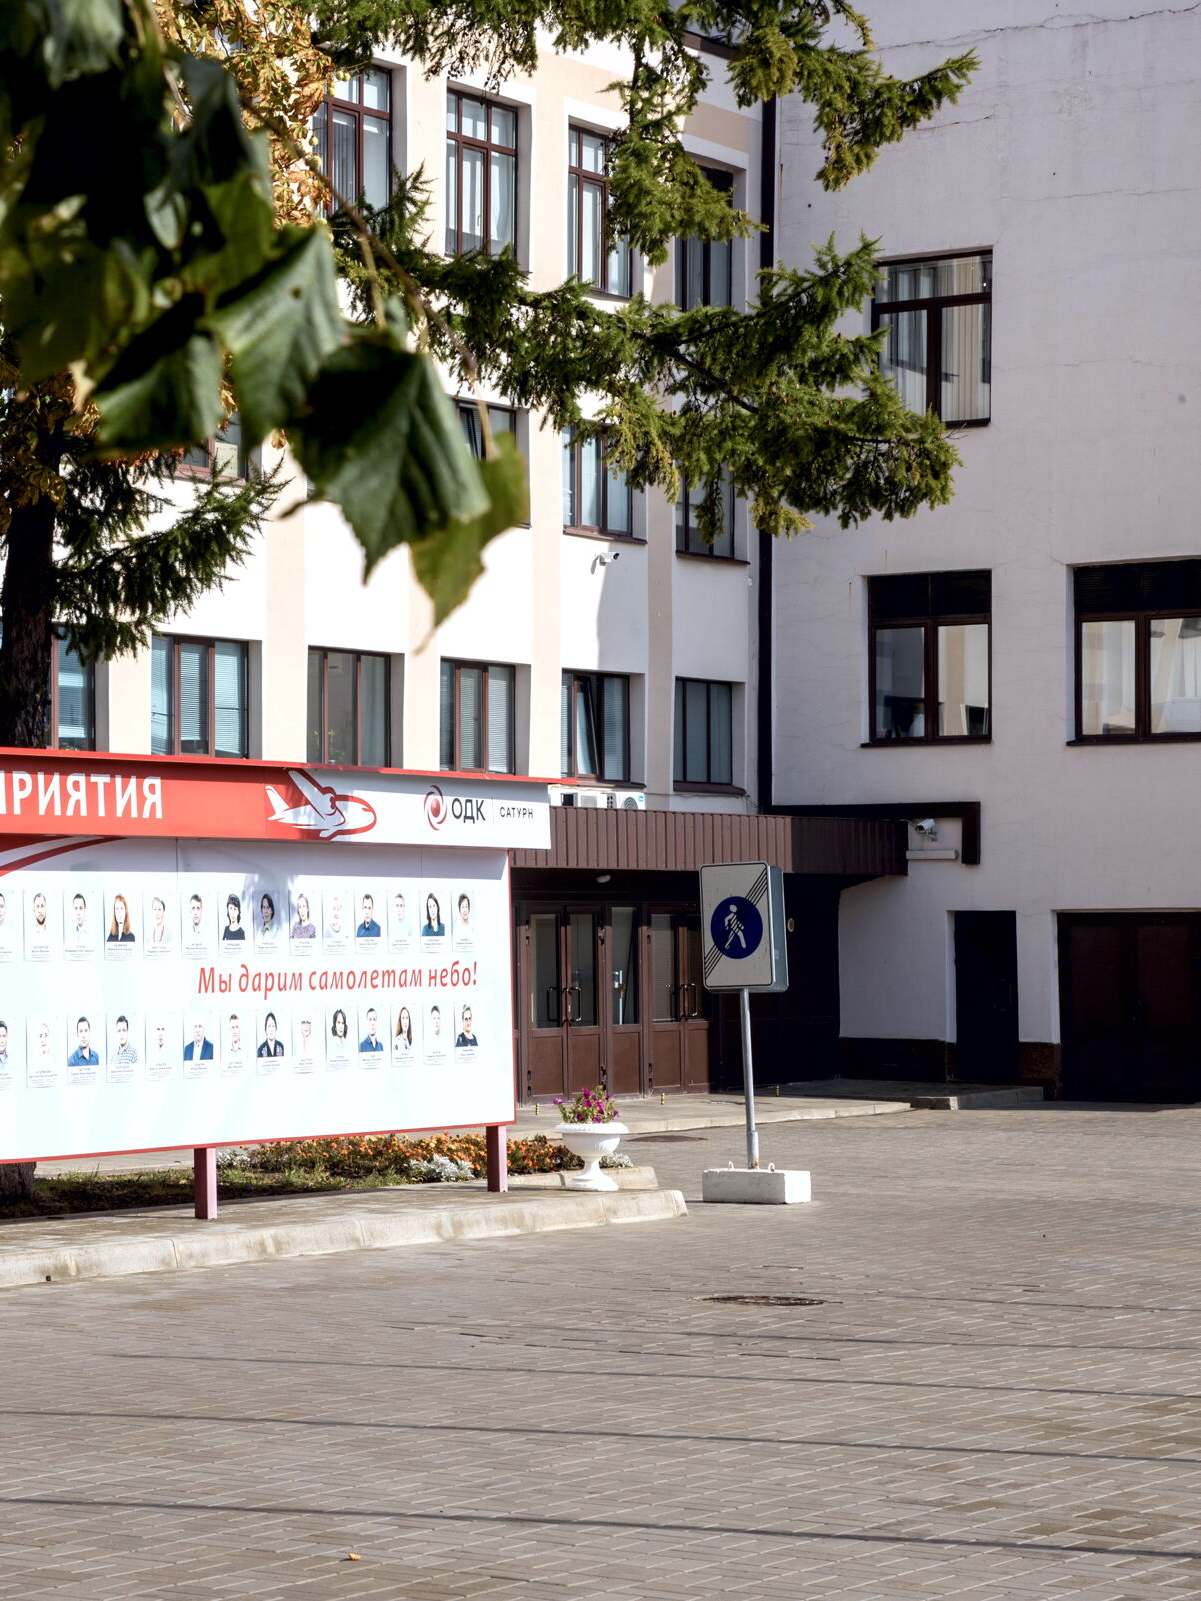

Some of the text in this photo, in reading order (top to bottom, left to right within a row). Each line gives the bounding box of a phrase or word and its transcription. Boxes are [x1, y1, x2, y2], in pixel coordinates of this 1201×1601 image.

[451, 797, 486, 824] ОДК
[499, 806, 534, 819] САТУРН
[198, 961, 478, 1001] Мы дарим самолетам небо!
